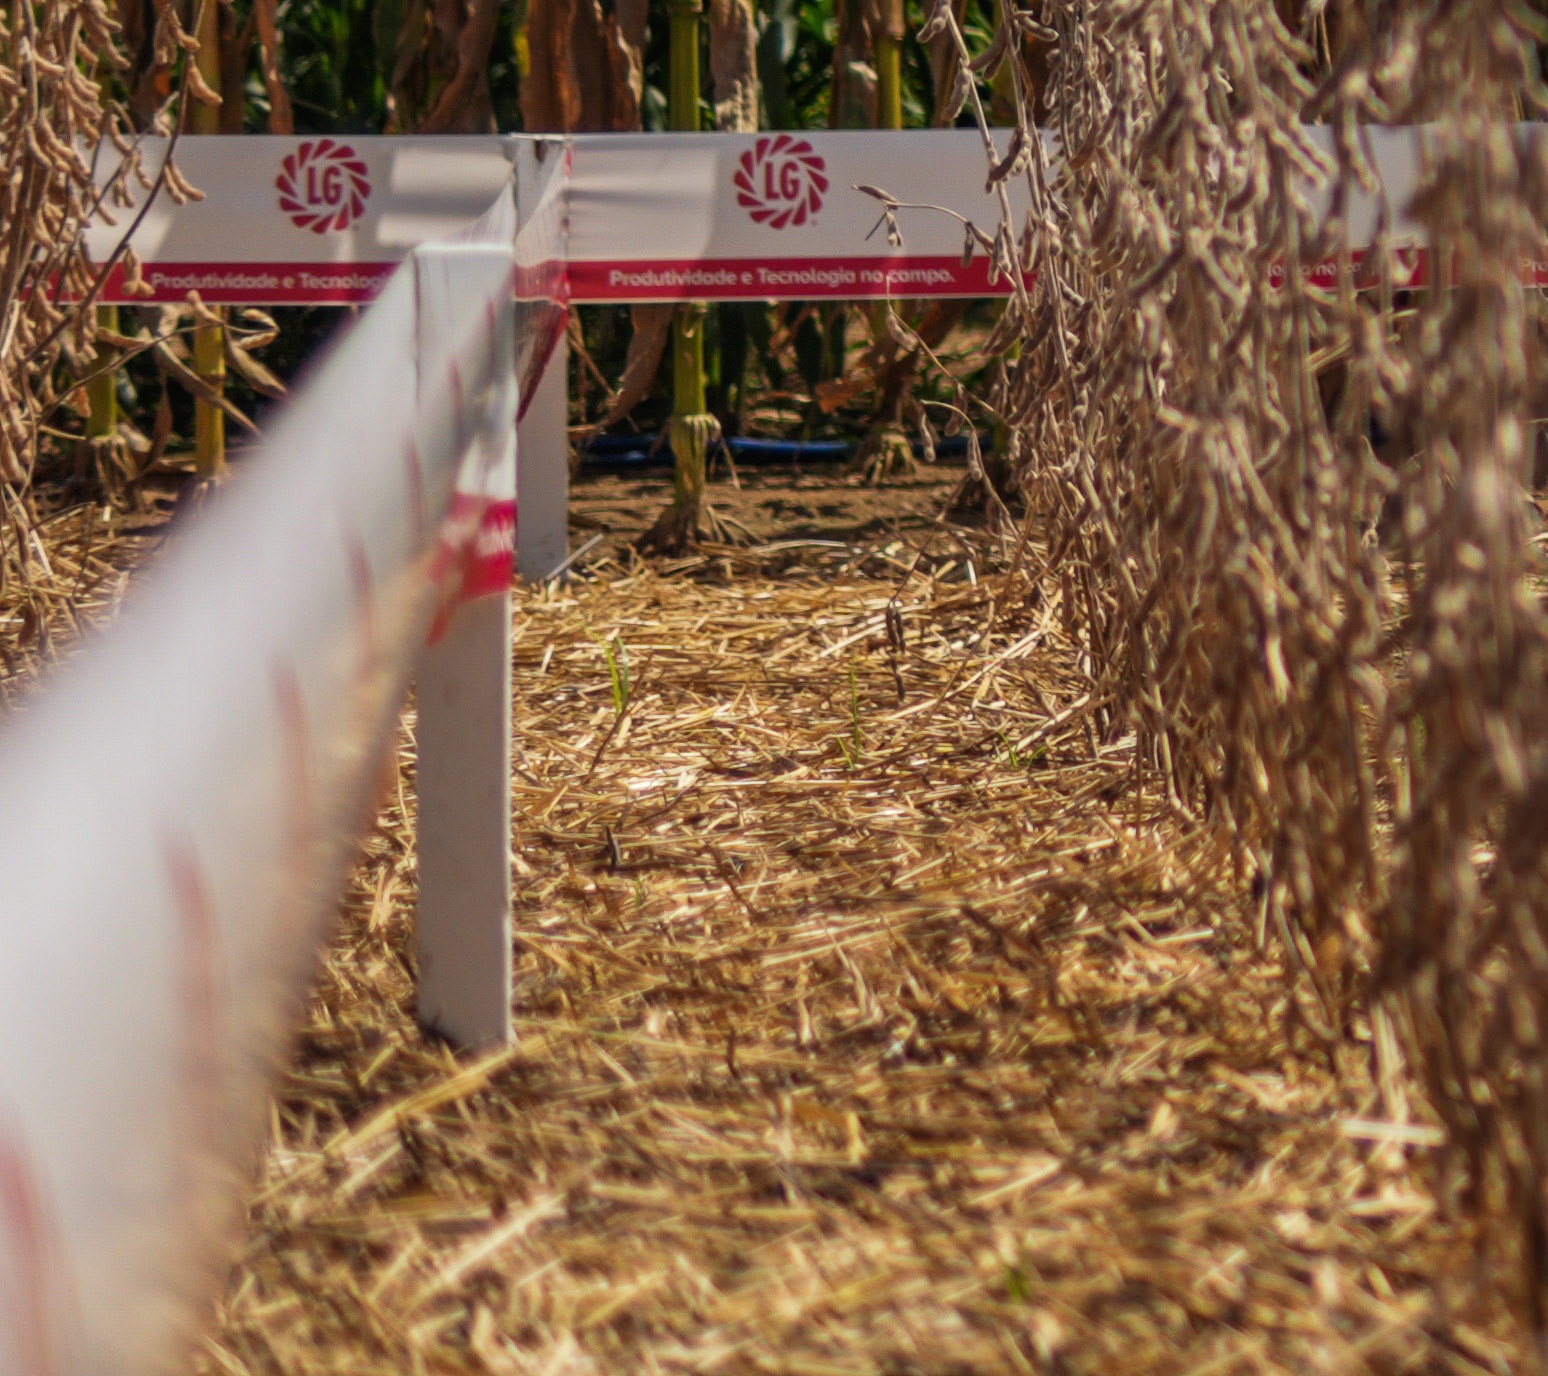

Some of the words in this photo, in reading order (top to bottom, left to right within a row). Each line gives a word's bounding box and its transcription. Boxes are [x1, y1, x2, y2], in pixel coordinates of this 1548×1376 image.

[307, 166, 343, 206] LG
[765, 161, 801, 202] LG
[151, 271, 279, 289] Produtividade
[282, 275, 295, 289] e
[609, 267, 738, 287] Produtividade
[741, 271, 754, 285] e
[757, 267, 856, 289] Tecnologia
[861, 268, 885, 284] no
